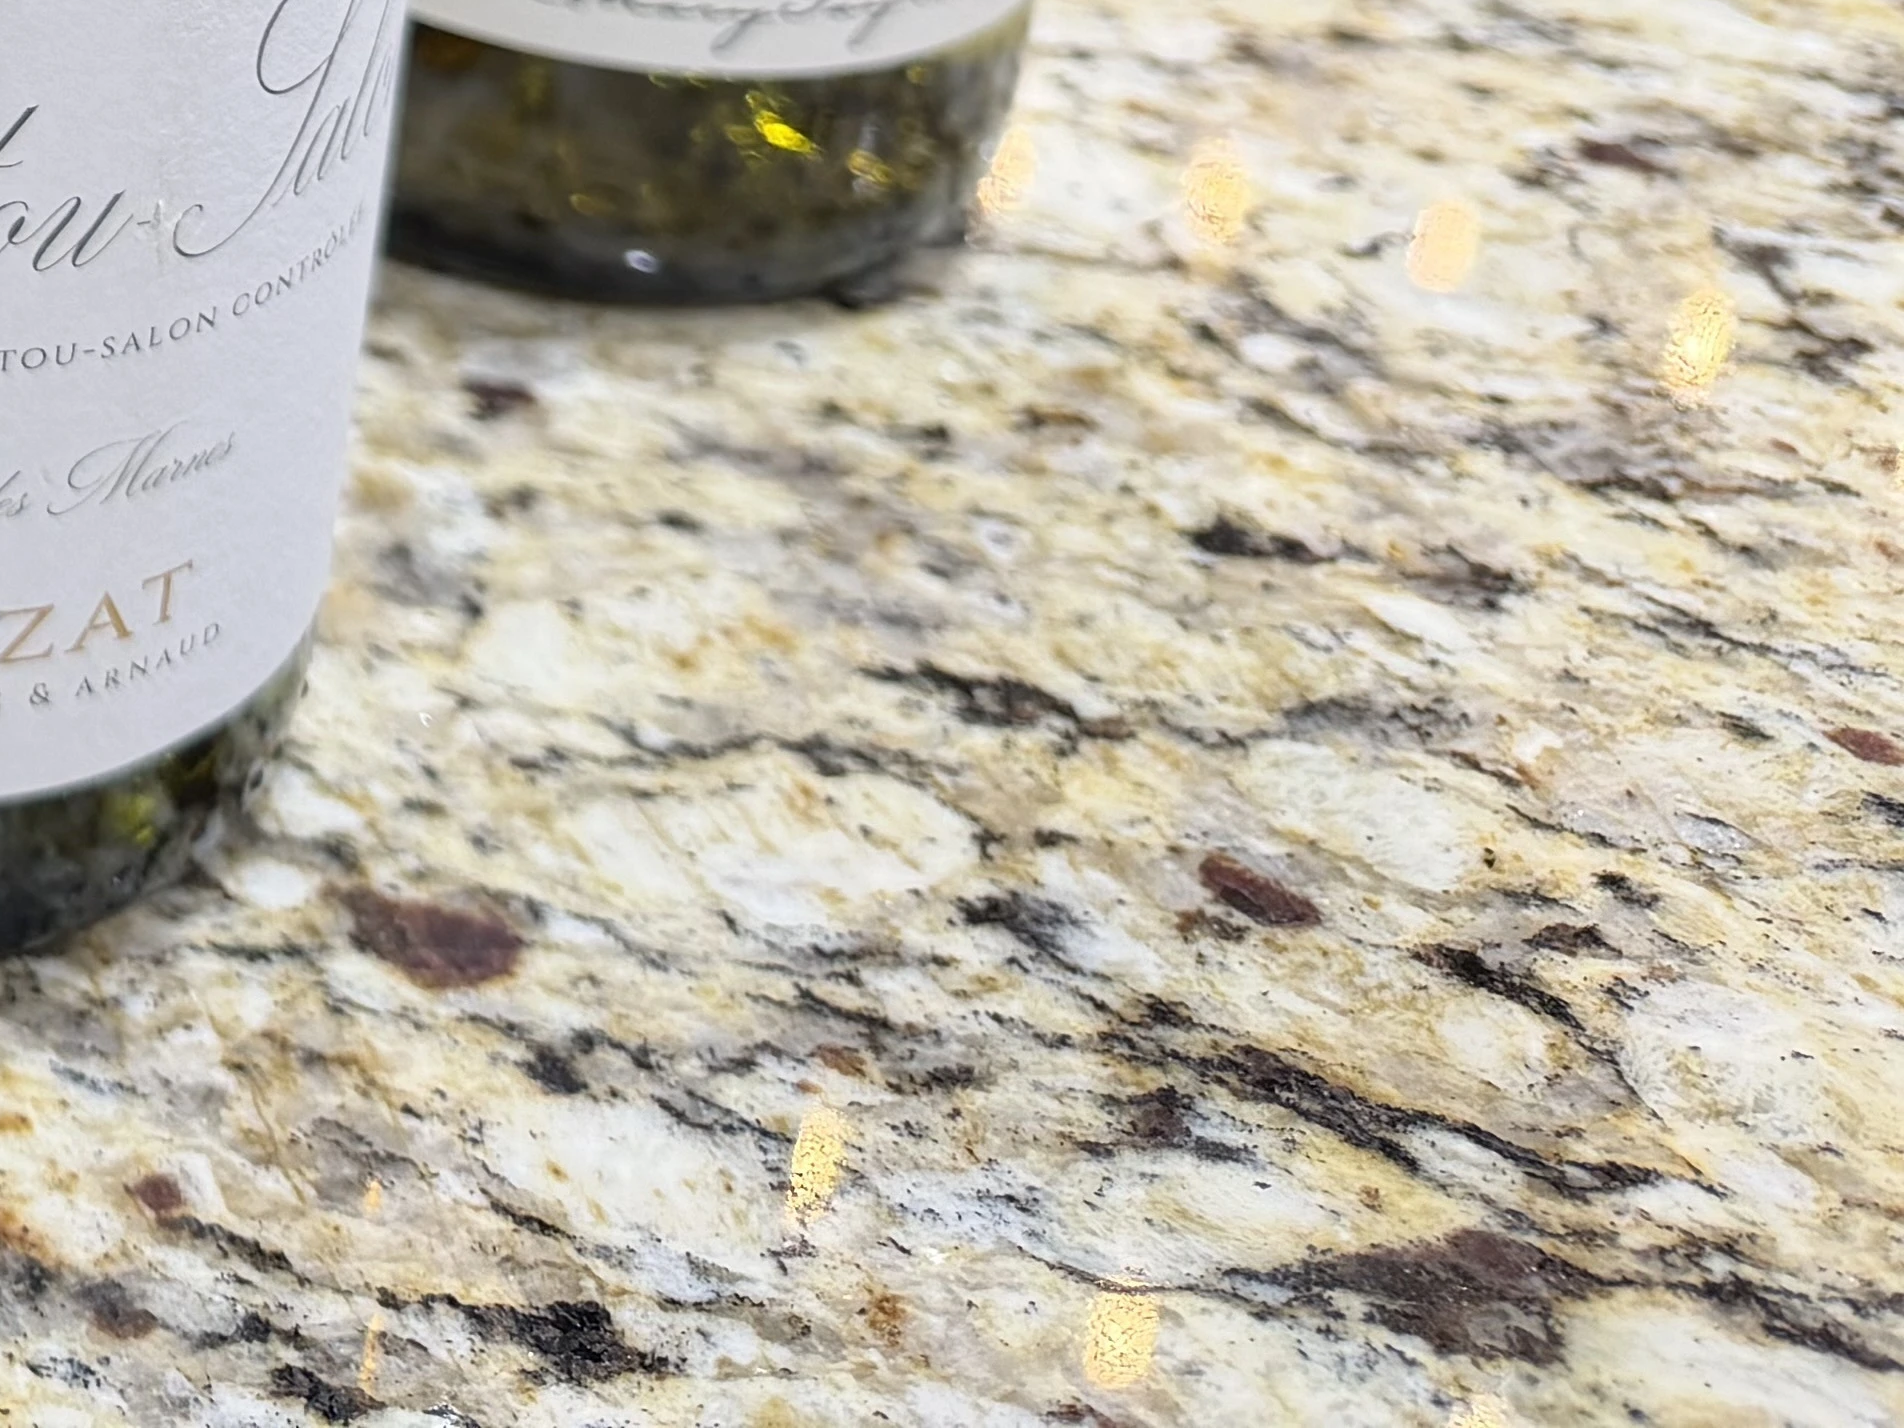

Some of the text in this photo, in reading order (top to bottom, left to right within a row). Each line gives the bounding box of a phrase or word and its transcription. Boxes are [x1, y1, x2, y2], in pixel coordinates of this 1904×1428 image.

[46, 420, 237, 517] Marnes
[29, 681, 51, 708] &
[74, 621, 223, 699] ARNAUD
